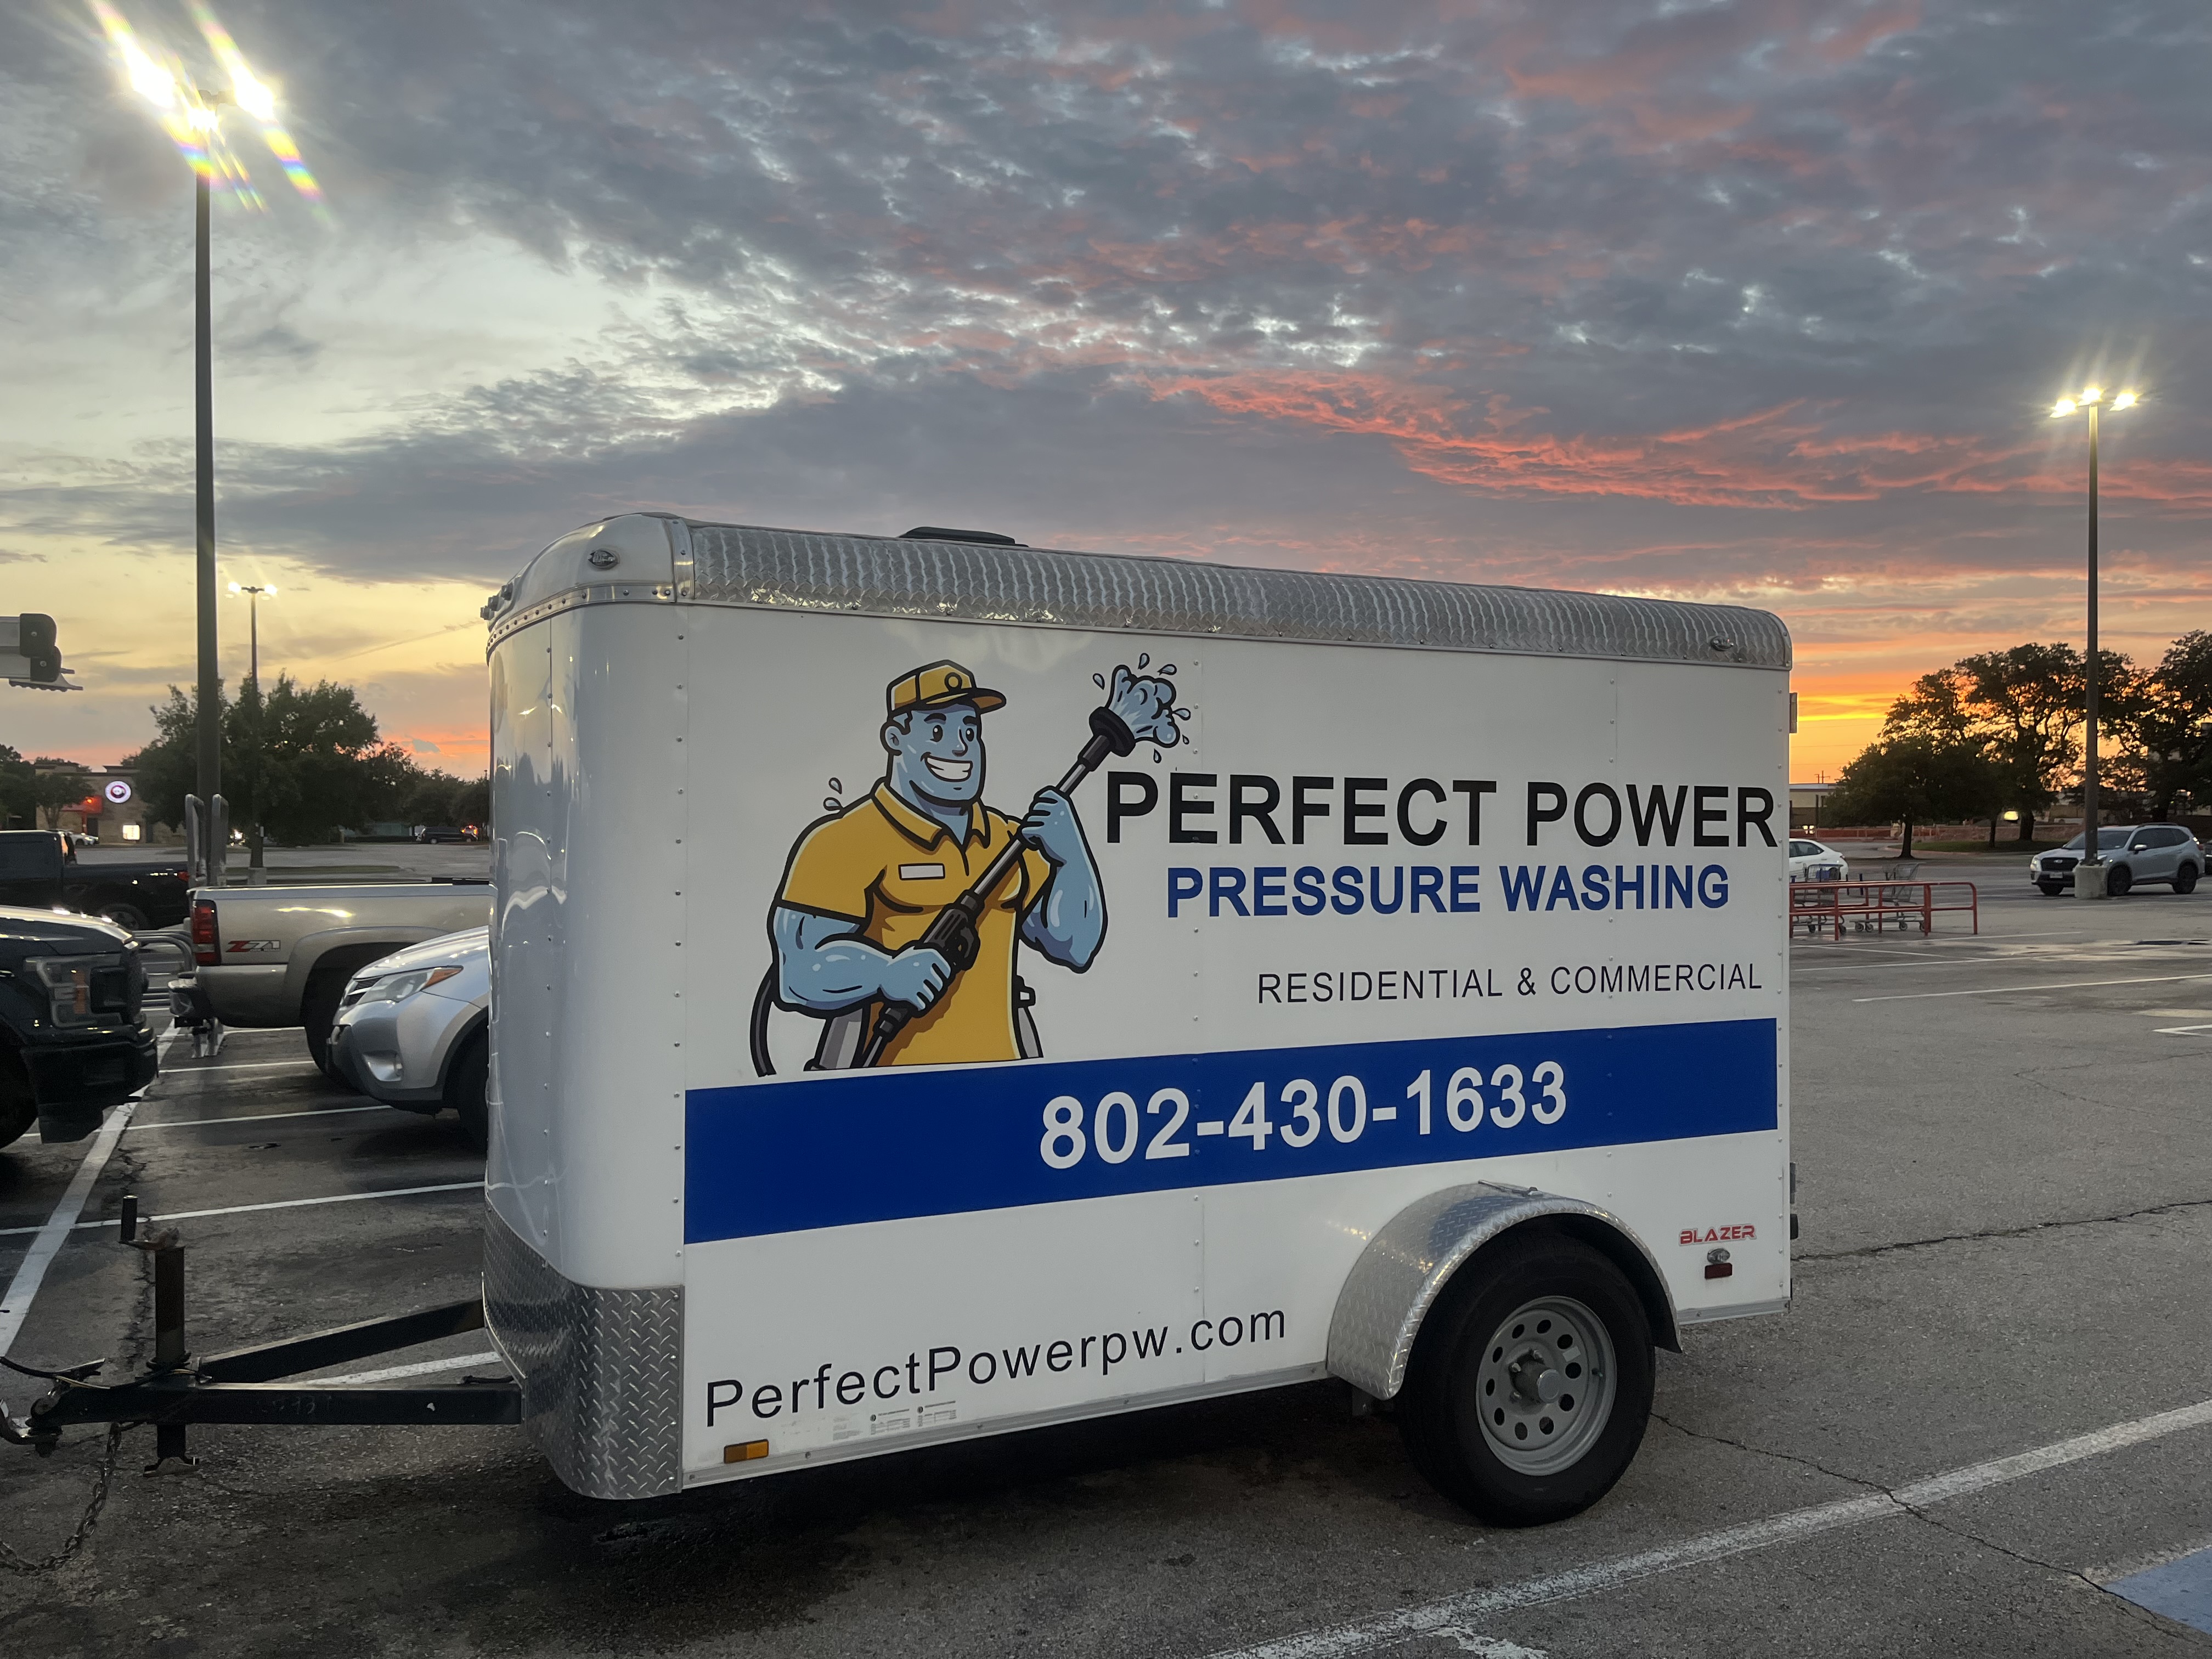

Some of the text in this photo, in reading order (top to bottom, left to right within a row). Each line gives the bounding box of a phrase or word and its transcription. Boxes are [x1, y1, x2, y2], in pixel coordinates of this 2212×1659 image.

[1107, 771, 1779, 848] PERFECT POWER
[1168, 864, 1728, 918] PRESSURE WASHING
[225, 940, 281, 953] Z71
[1258, 962, 1763, 1004] RESIDENTIAL & COMMERCIAL
[1040, 1060, 1567, 1170] 802-430-1633
[1679, 1224, 1756, 1245] BLAZER
[706, 1310, 1286, 1428] PerfectPowerpw.com
